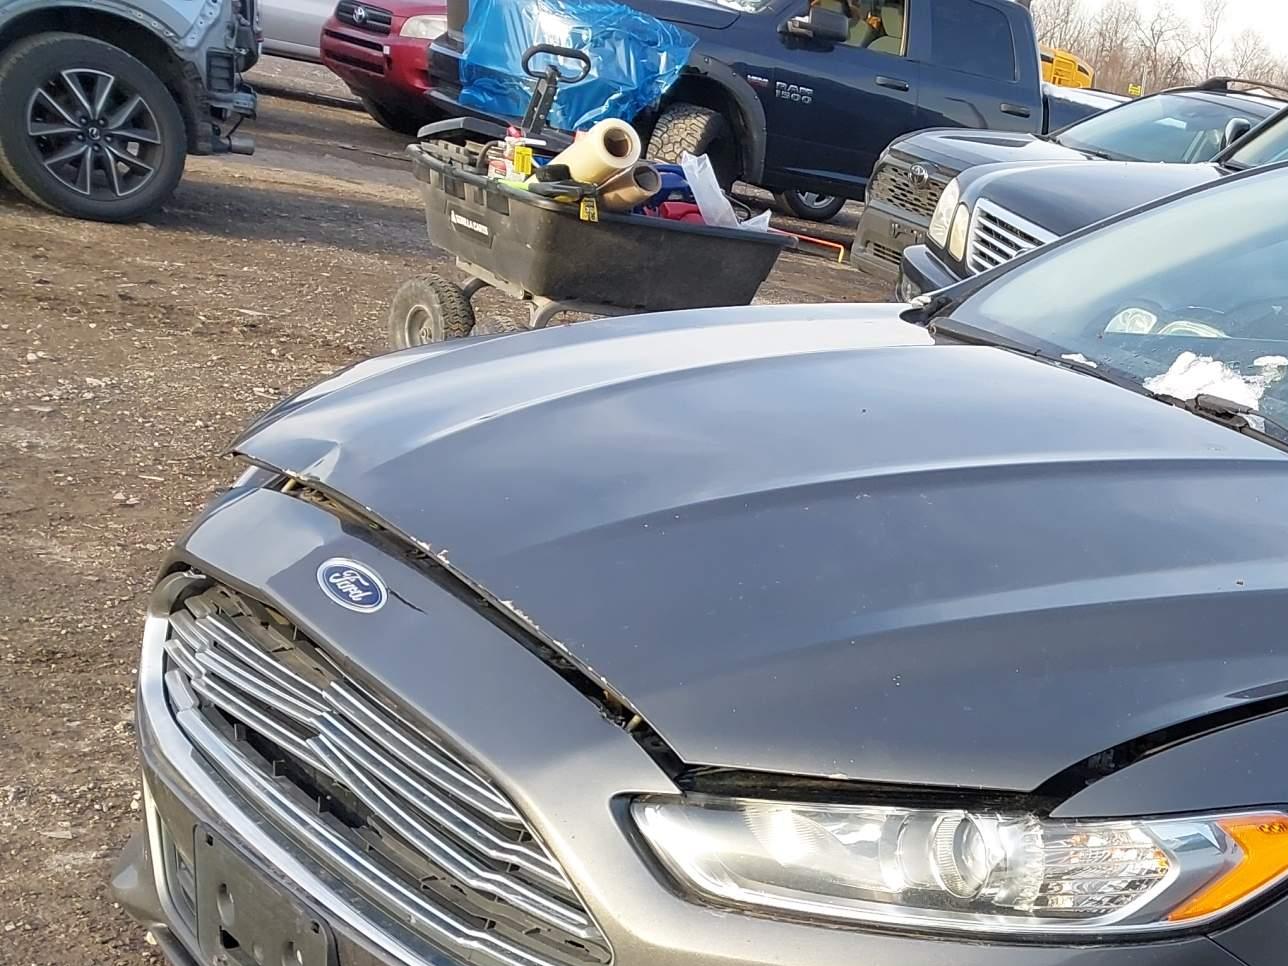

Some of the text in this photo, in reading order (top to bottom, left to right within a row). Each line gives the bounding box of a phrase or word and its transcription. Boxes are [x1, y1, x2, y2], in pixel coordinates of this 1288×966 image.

[776, 81, 814, 95] RAM
[776, 90, 812, 104] 1500
[329, 570, 373, 601] Ford
